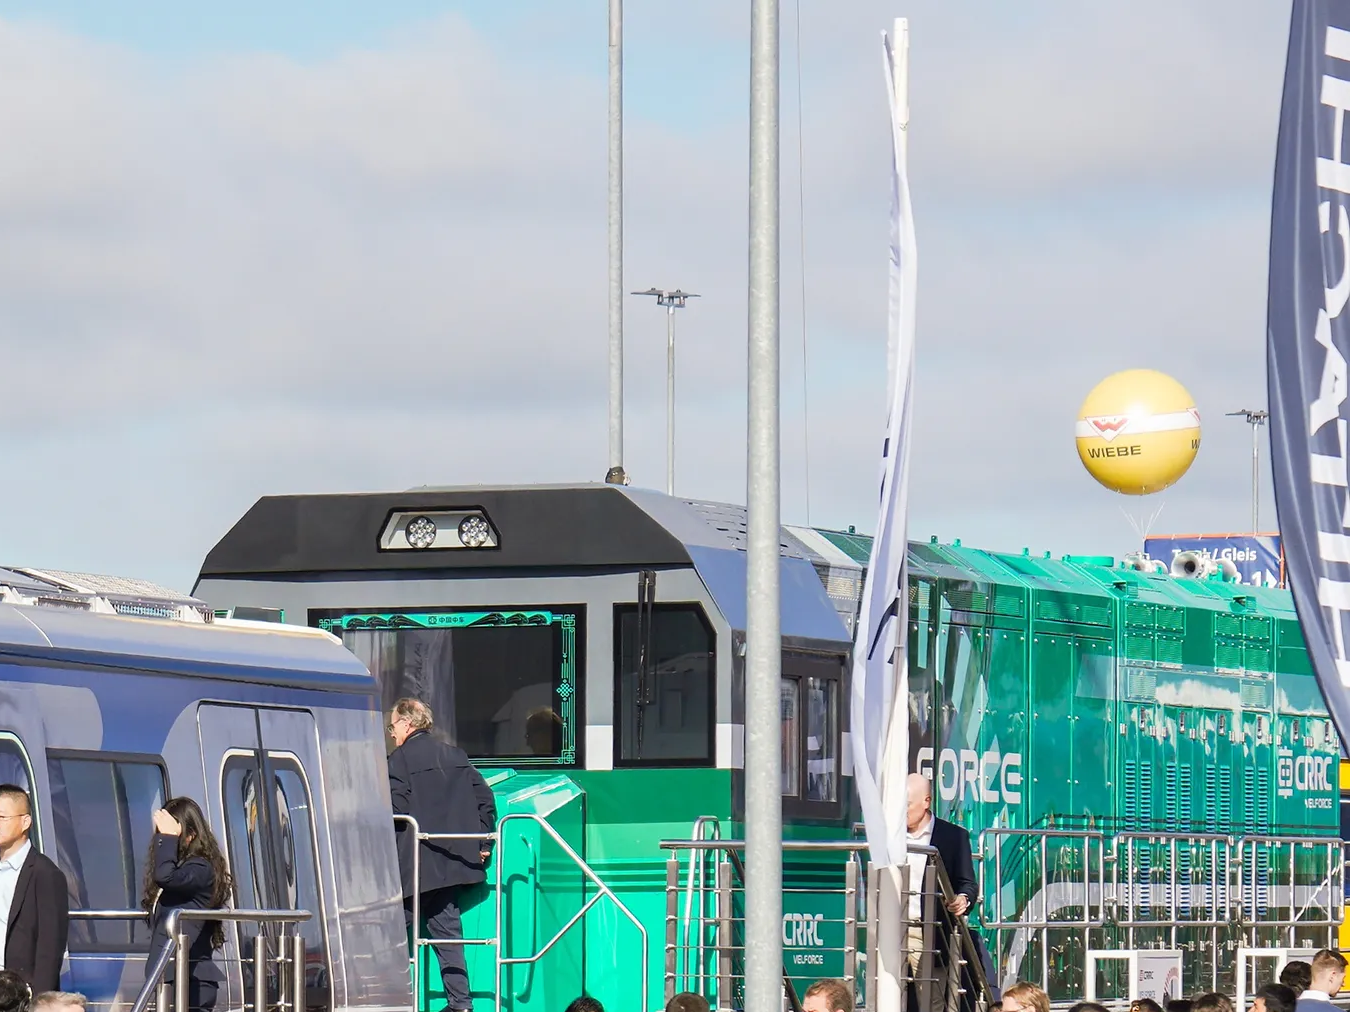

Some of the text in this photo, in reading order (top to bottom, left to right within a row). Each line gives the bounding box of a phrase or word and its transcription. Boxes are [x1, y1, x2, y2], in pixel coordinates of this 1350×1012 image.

[1087, 445, 1142, 459] WIEBE
[1221, 547, 1257, 561] Gleis
[1295, 755, 1333, 791] CRRC
[782, 913, 824, 946] CRRC
[793, 954, 824, 965] VELFORCE
